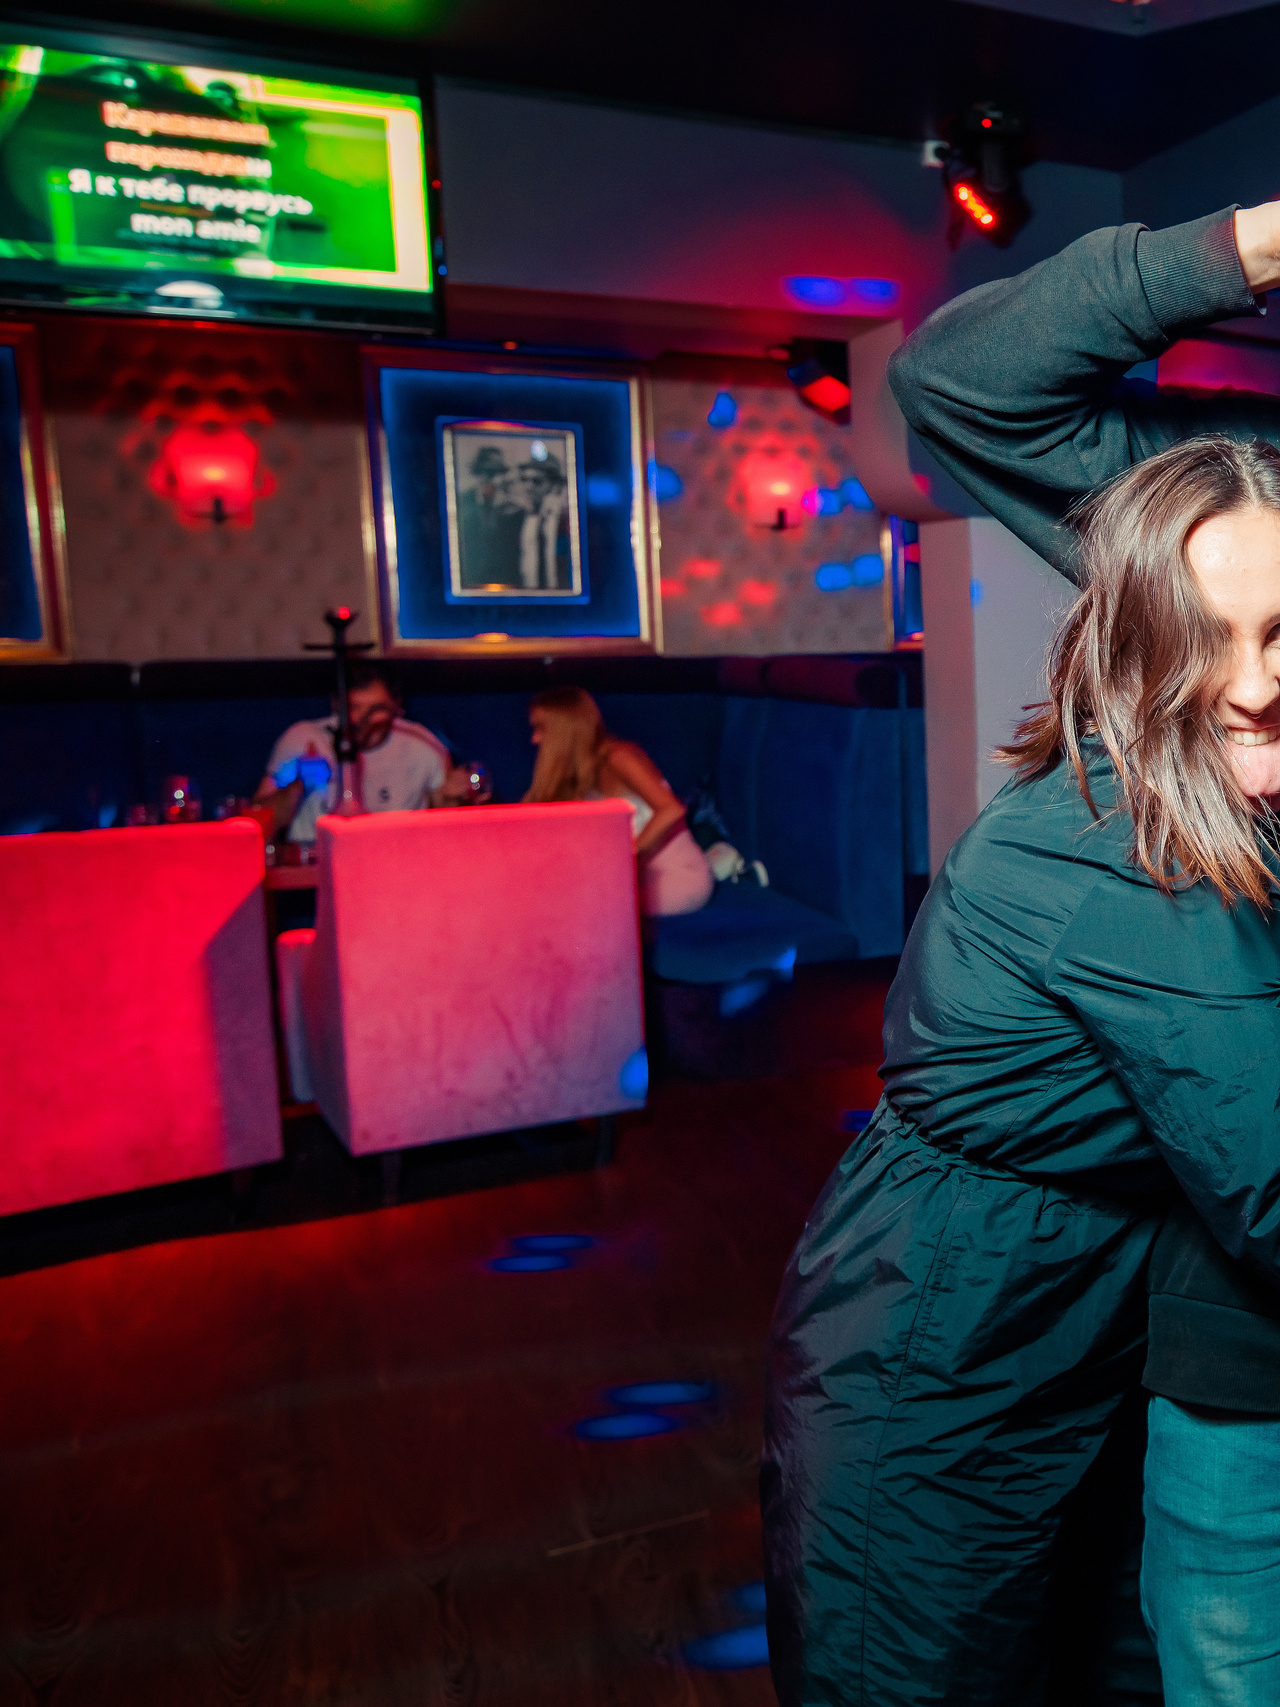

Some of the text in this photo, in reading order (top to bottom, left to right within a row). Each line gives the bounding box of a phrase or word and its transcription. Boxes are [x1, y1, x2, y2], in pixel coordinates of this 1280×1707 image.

[68, 168, 313, 216] Я к тебе прорвусь
[130, 213, 261, 243] mon amie
